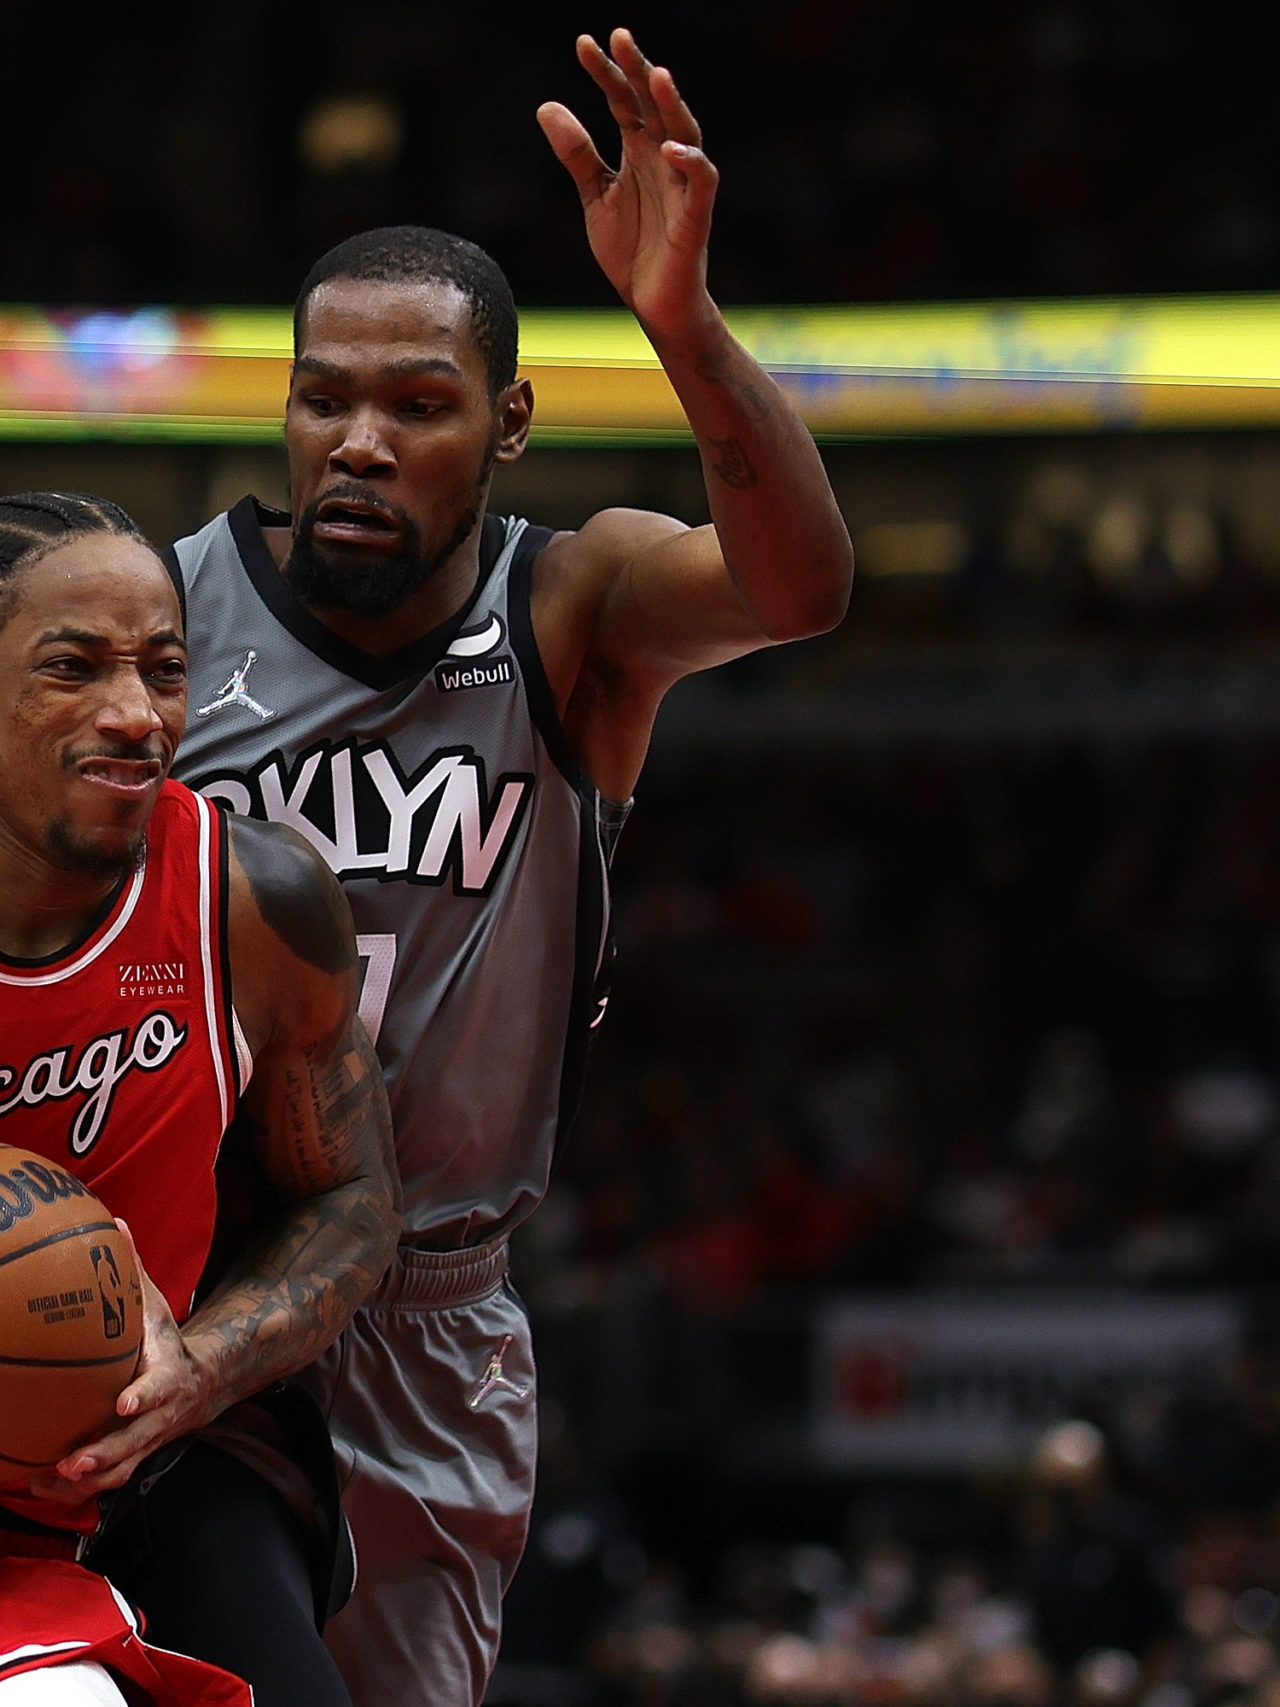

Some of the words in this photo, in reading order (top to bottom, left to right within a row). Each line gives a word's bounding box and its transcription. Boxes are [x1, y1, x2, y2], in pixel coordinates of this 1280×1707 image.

[441, 662, 511, 690] Webull
[119, 963, 184, 982] ZENNI
[120, 984, 184, 997] EYEWEAR
